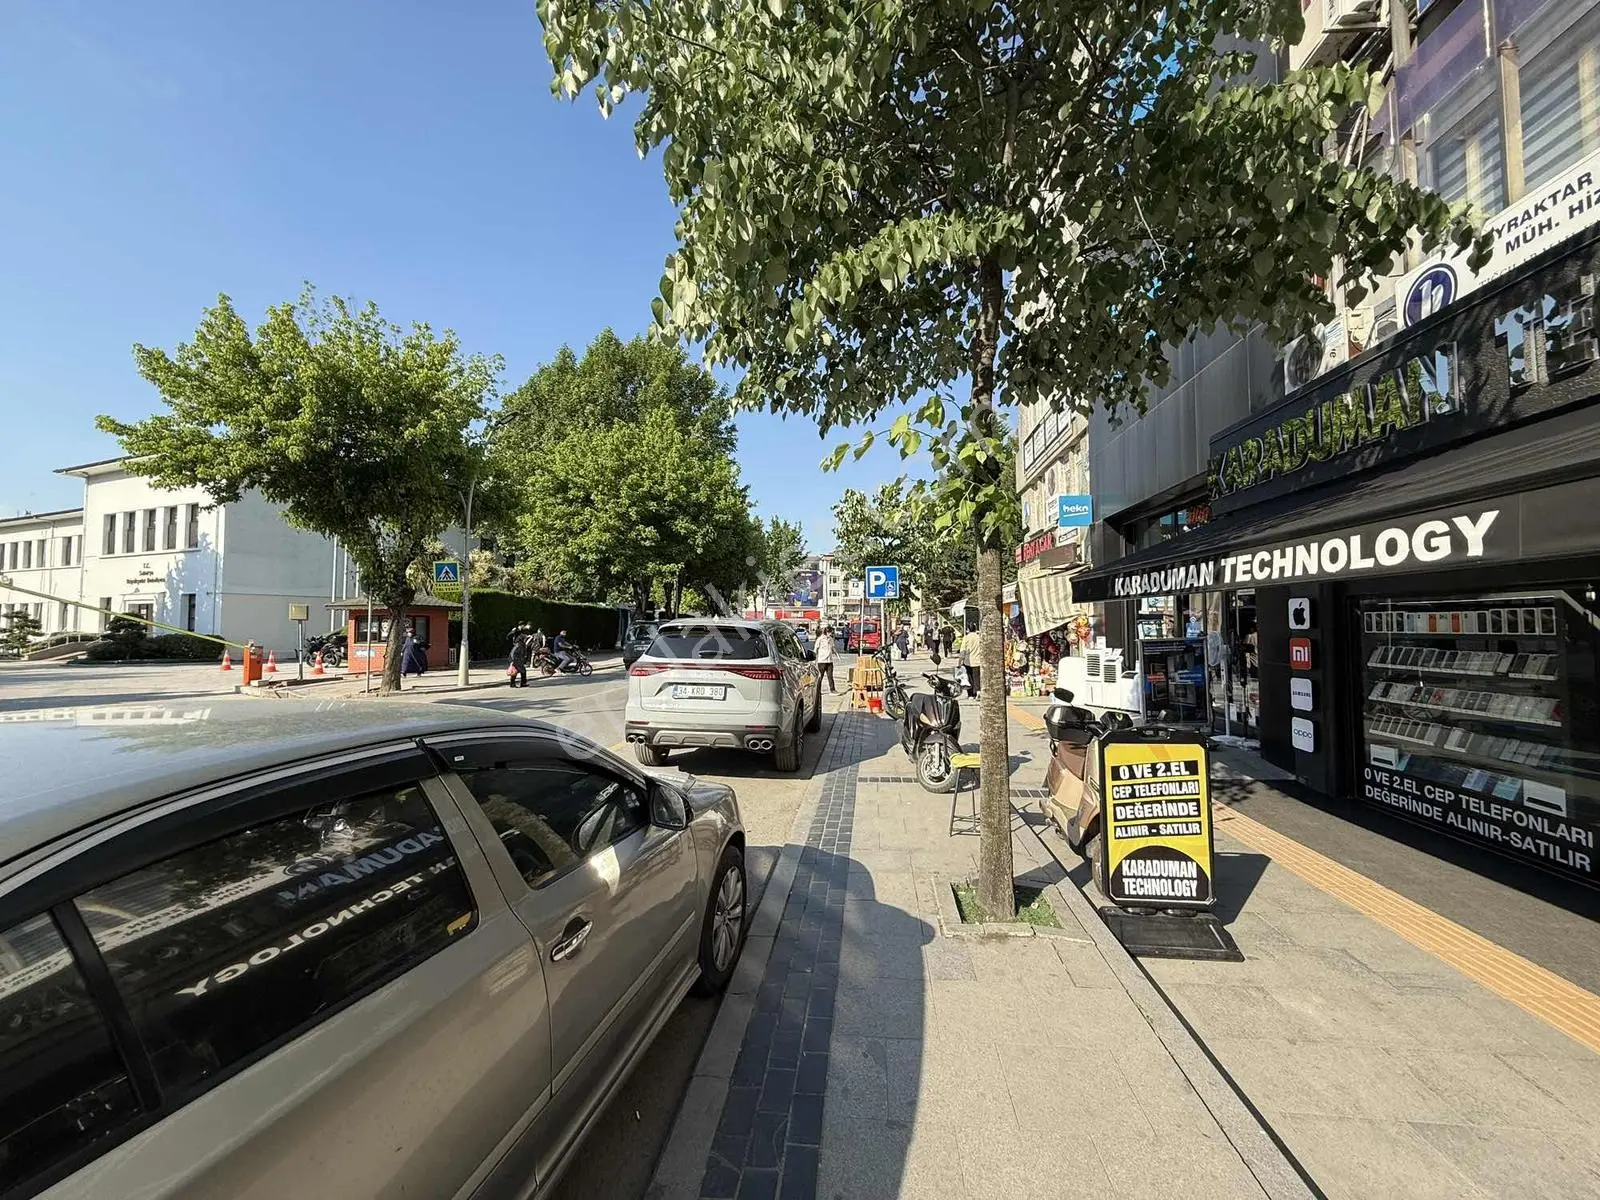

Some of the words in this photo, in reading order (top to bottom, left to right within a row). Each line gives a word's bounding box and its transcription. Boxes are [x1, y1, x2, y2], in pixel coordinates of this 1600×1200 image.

[1493, 171, 1593, 239] YRAKTAR
[1505, 217, 1560, 255] MÜH.
[1208, 341, 1460, 500] KARADUMAN
[1114, 560, 1215, 597] KARADUMAN
[1220, 510, 1500, 584] TECHNOLOGY
[870, 571, 887, 594] P
[678, 686, 687, 695] 34
[1133, 763, 1152, 779] VE
[1155, 761, 1190, 777] 2.EL
[1112, 785, 1132, 799] CEP
[1134, 781, 1199, 798] TELEFONLARI
[1115, 801, 1199, 820] DEĞERİNDE
[1373, 769, 1390, 785] VE
[1392, 774, 1421, 795] 2.EL
[1424, 785, 1455, 804] CEP
[1458, 794, 1594, 849] TELEFONLARI
[1115, 824, 1149, 838] ALINIR
[1159, 823, 1201, 835] SATILIR
[1365, 784, 1443, 822] DEĞERİNDE
[1447, 811, 1591, 872] ALINIR-SATILIR
[1121, 859, 1198, 878] KARADUMAN
[1122, 877, 1198, 897] TECHNOLOGY
